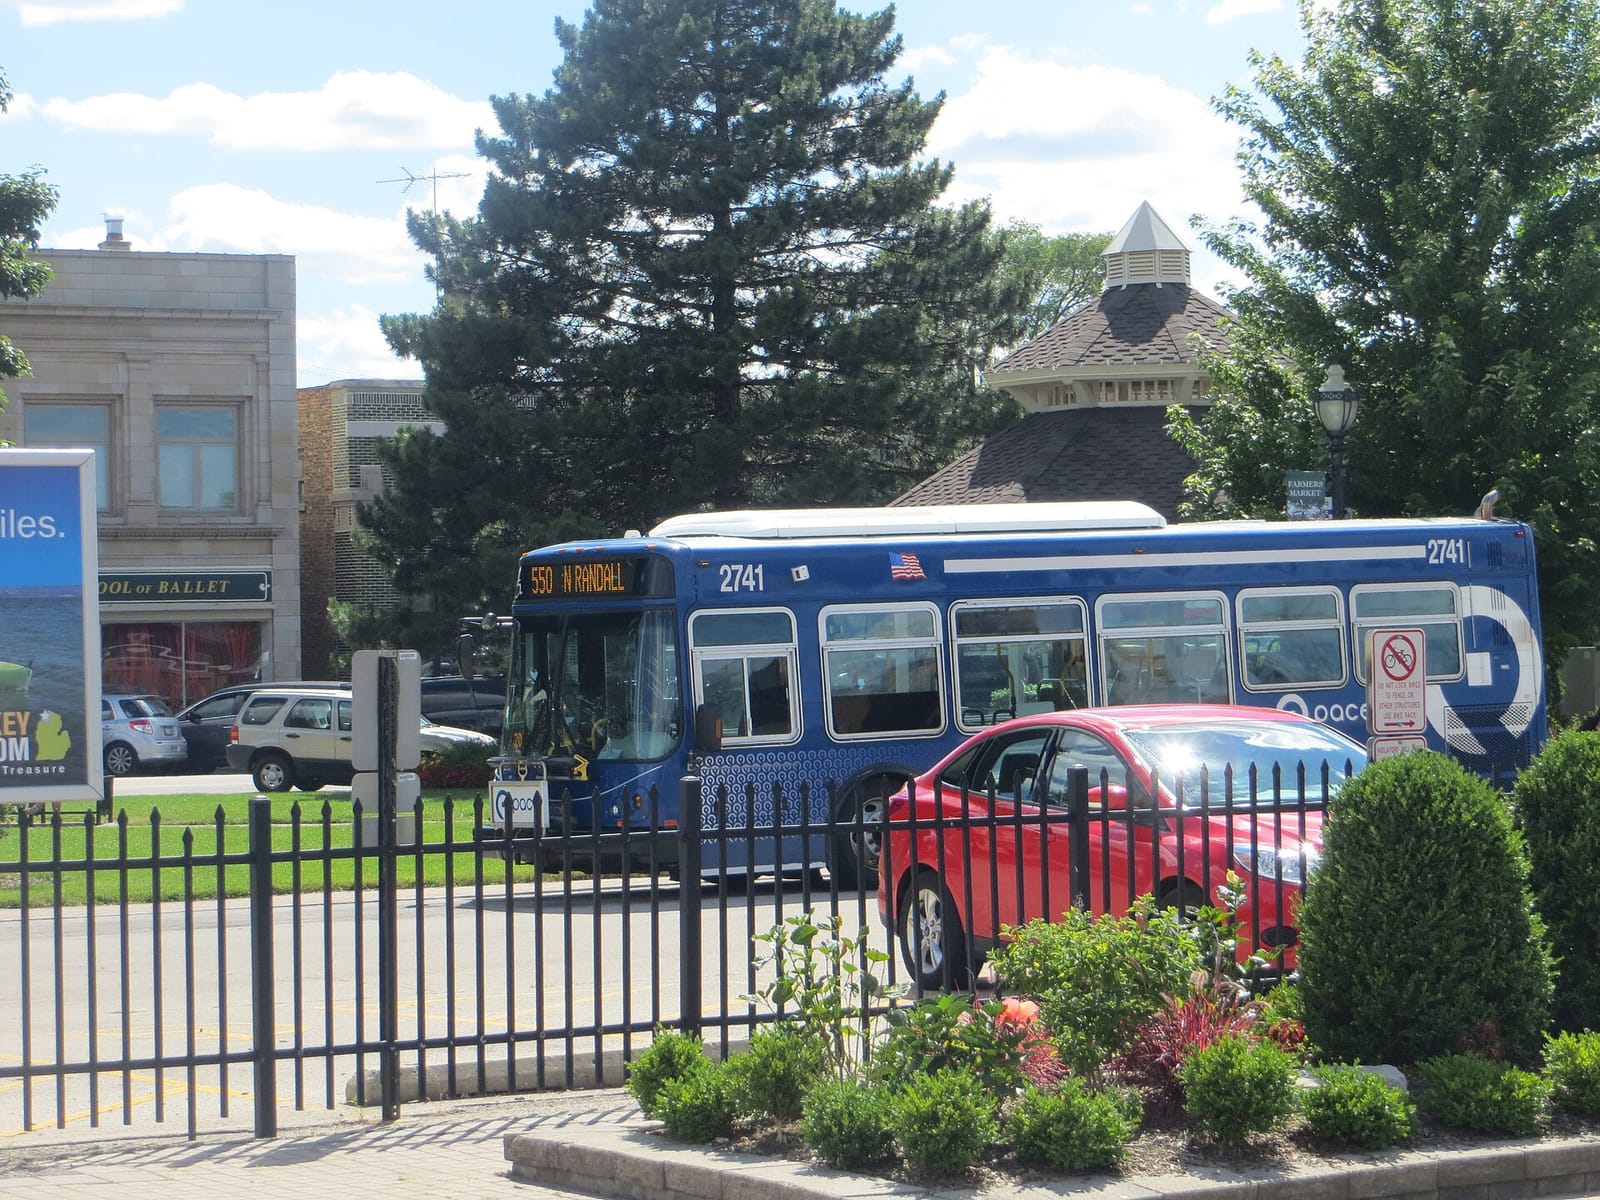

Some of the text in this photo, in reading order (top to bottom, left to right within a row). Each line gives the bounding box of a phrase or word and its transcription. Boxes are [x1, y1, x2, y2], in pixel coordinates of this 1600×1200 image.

[1287, 480, 1323, 488] FARMERS
[1289, 489, 1321, 497] MARKET
[1428, 539, 1465, 564] 2741
[530, 562, 625, 594] 550 N RANDALL
[719, 563, 764, 592] 2741
[158, 580, 230, 594] BALLET
[1394, 701, 1421, 709] STRUCTURES
[1404, 711, 1416, 719] RACK
[0, 711, 30, 736] EY
[2, 765, 65, 775] Treasure
